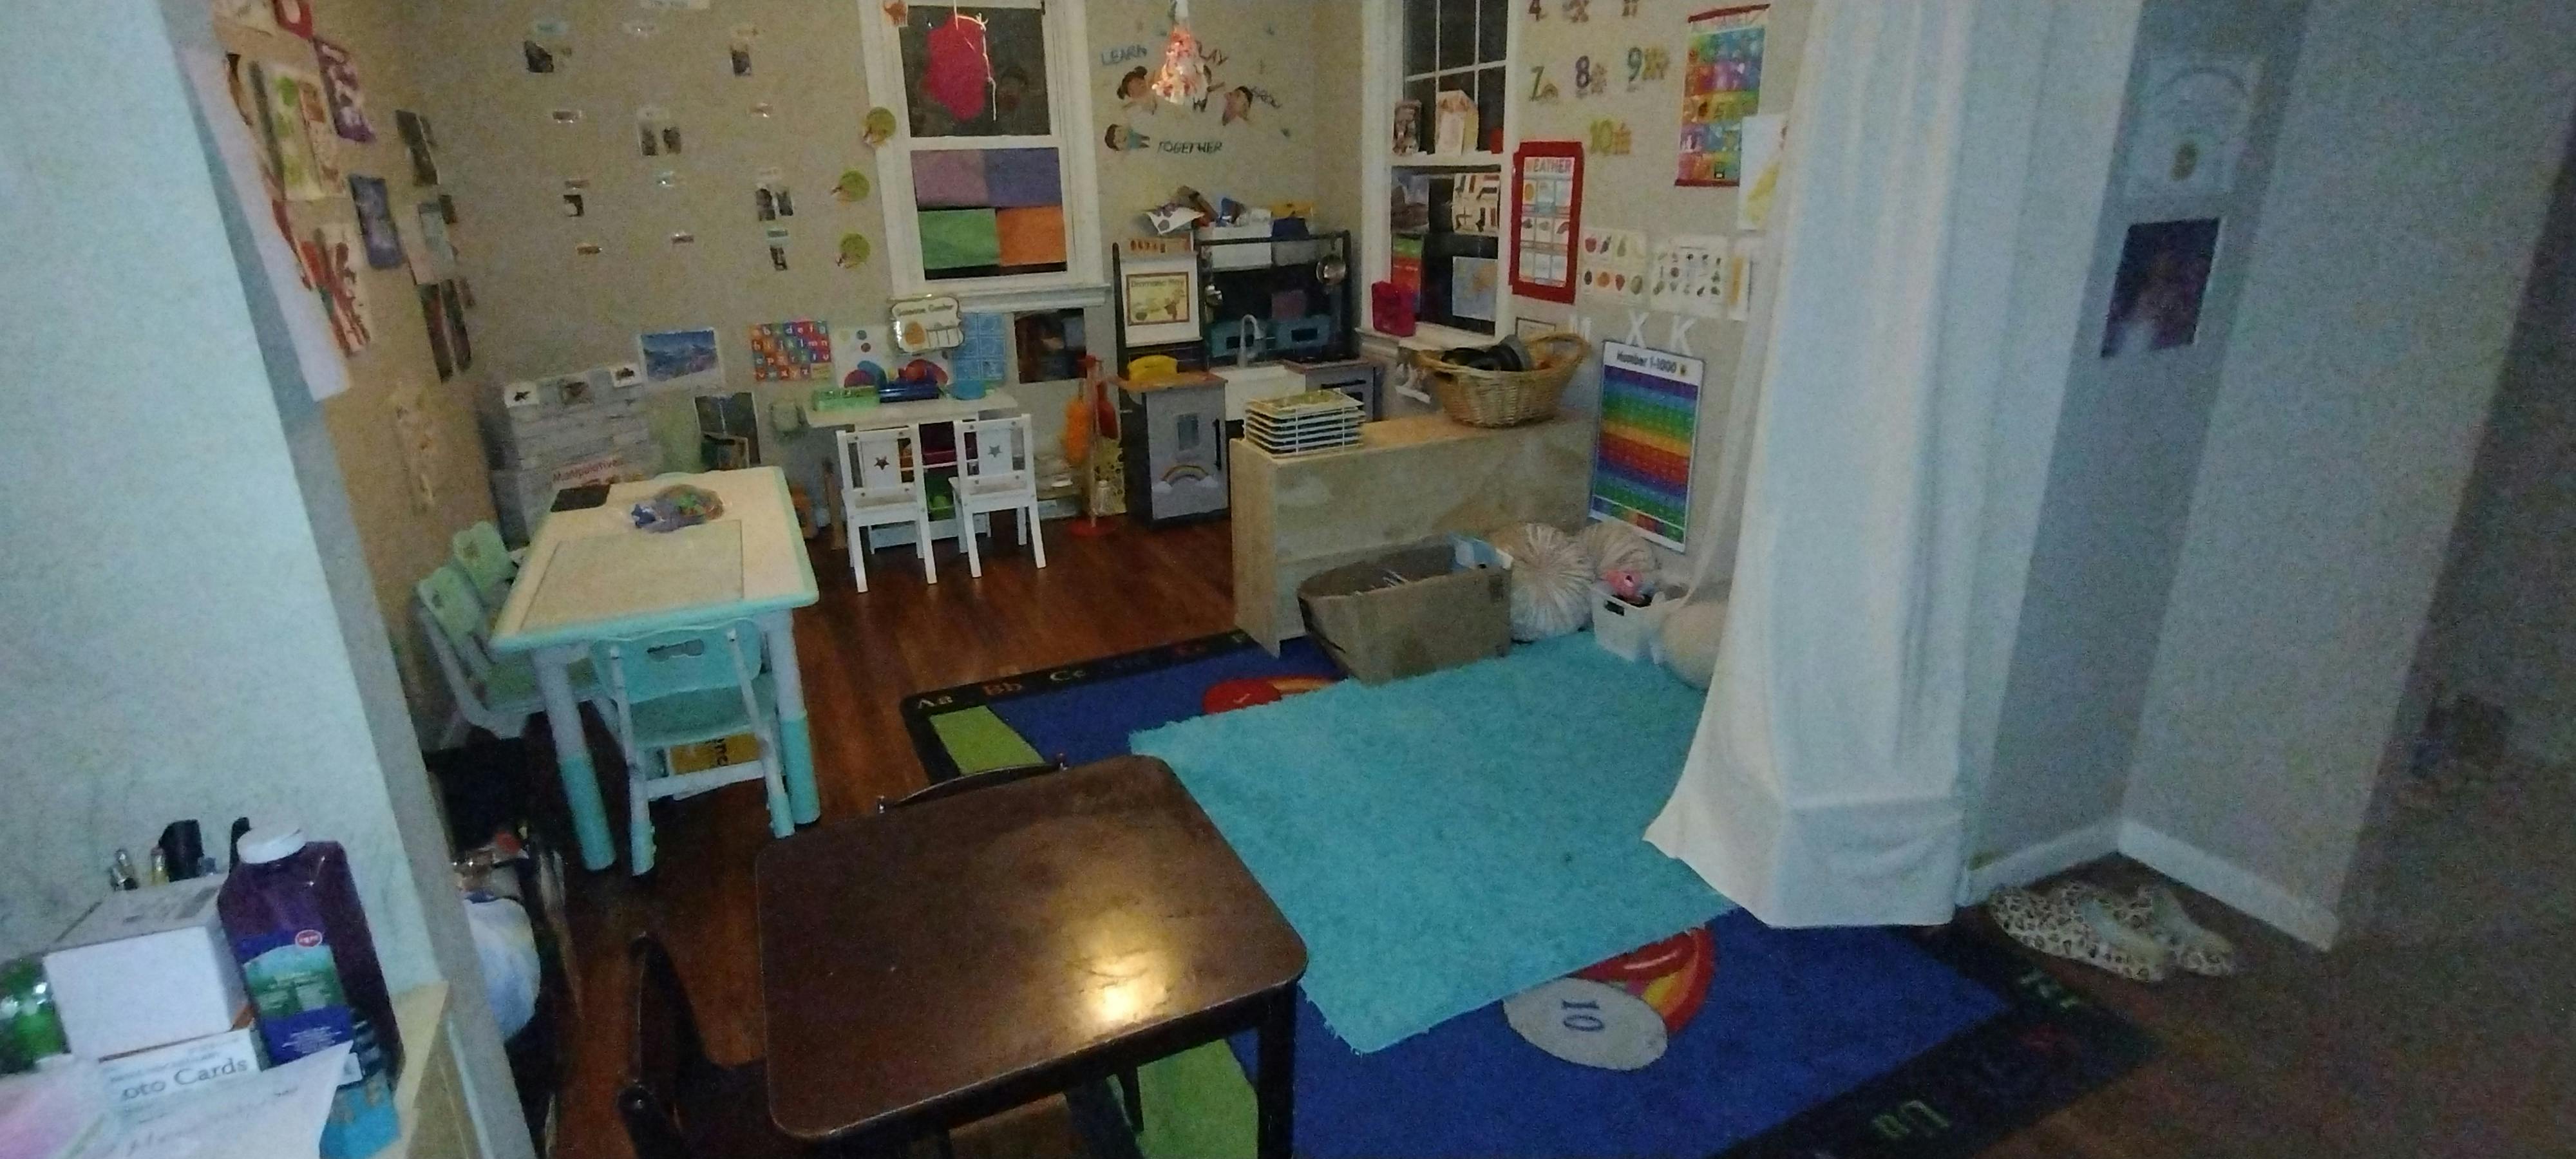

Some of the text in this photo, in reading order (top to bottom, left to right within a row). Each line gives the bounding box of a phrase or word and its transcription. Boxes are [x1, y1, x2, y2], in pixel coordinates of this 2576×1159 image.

[1101, 44, 1147, 65] LEARN
[1530, 47, 1642, 101] 7 8 9
[1157, 139, 1223, 154] TOGETHER
[1589, 118, 1614, 153] 10
[1625, 309, 1698, 355] X K
[1617, 350, 1647, 367] Number
[983, 682, 1023, 695] Bb
[918, 695, 953, 709] Aa
[1561, 999, 1605, 1032] 10
[174, 1057, 248, 1085] Cards
